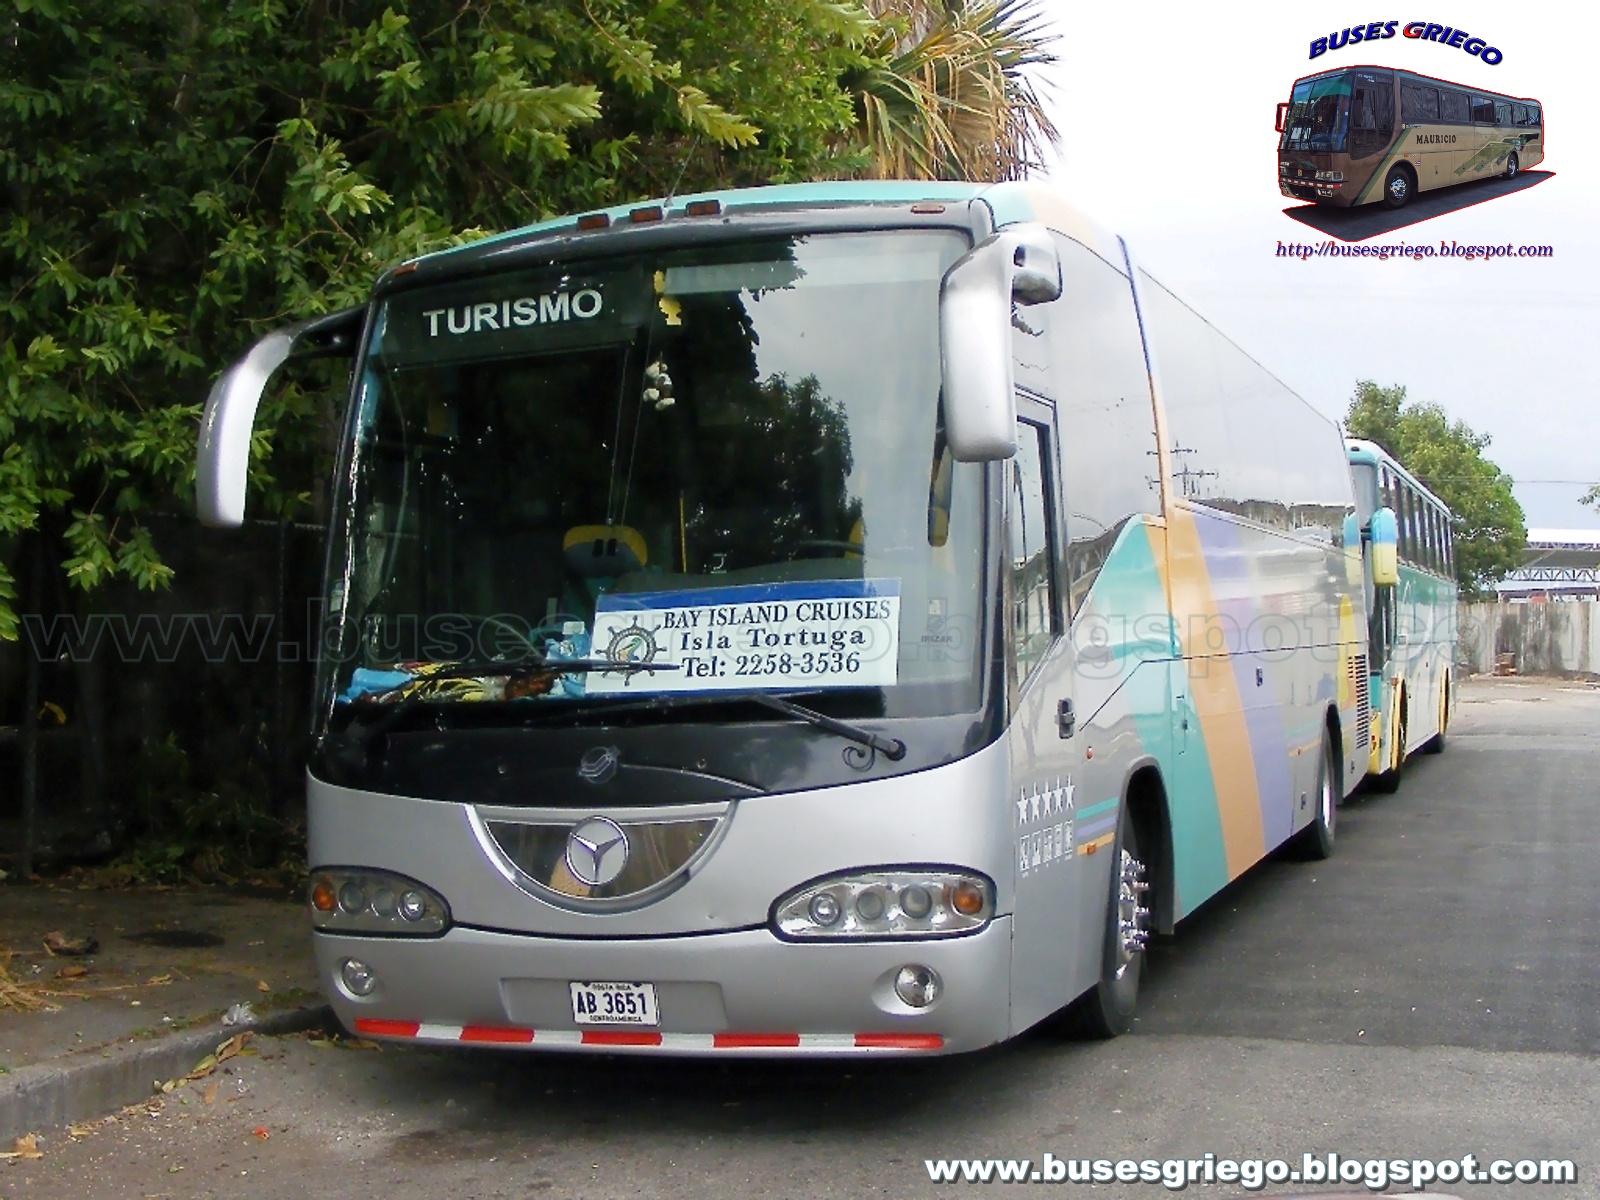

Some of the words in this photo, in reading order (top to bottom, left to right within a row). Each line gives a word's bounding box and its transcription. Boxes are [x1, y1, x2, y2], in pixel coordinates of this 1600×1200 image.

[422, 289, 603, 337] TURISMO
[663, 611, 702, 630] BAY
[707, 603, 788, 626] ISLAND
[795, 600, 891, 622] CRUISES
[680, 631, 732, 651] Isla
[746, 627, 866, 651] Tortuga
[681, 655, 726, 678] Tel:
[735, 651, 861, 676] 2258-3536
[577, 991, 597, 1014] AB
[602, 992, 647, 1015] 3651
